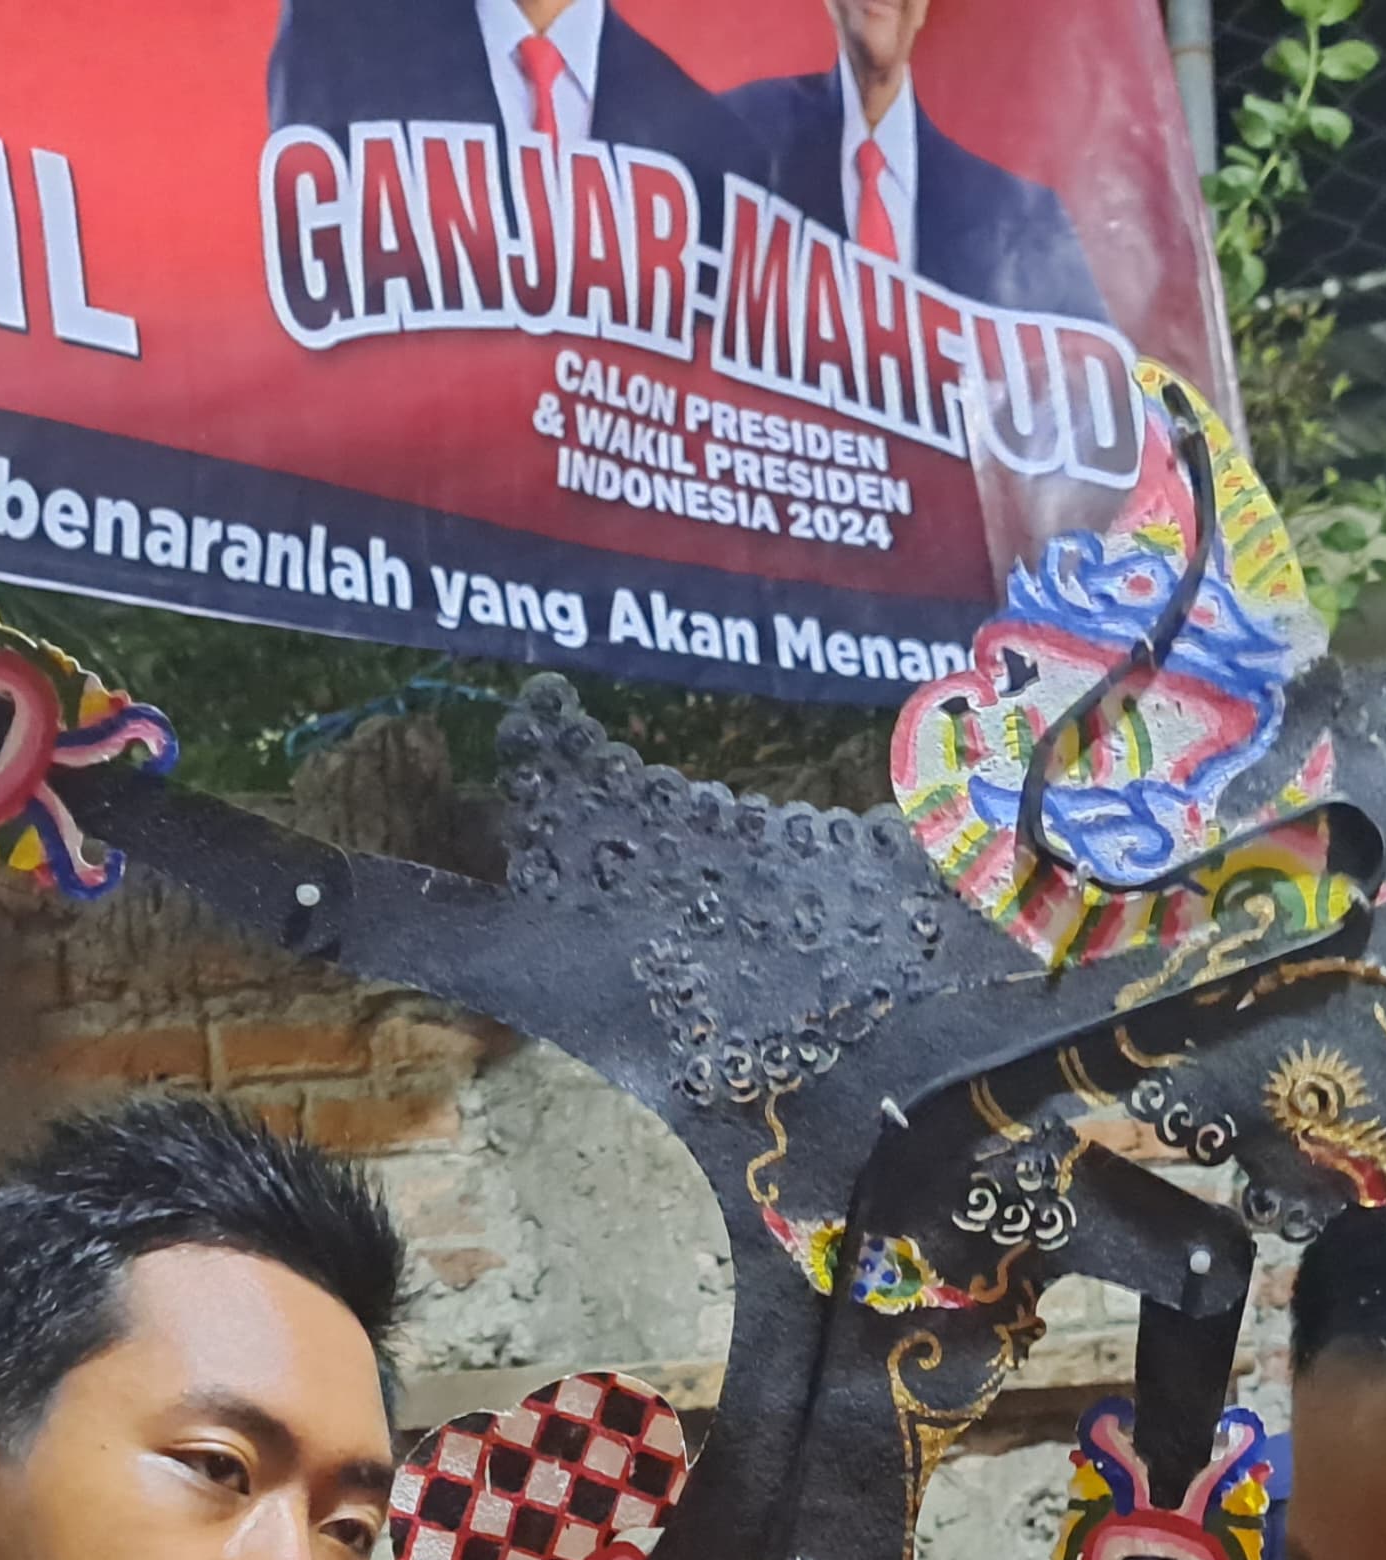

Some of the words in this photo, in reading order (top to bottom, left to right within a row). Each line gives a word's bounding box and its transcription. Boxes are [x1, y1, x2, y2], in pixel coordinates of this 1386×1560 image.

[258, 119, 1147, 490] GANJAR-MAHFUD
[532, 391, 566, 439] &
[574, 403, 697, 476] WAKIL
[703, 442, 911, 515] PRESIDEN
[555, 349, 677, 426] CALON
[685, 394, 888, 472] PRESIDEN
[557, 446, 780, 534] INDONESIA
[786, 502, 894, 551] 2024
[430, 564, 589, 648] yang
[608, 587, 760, 665] Akan
[773, 614, 975, 683] Menan
